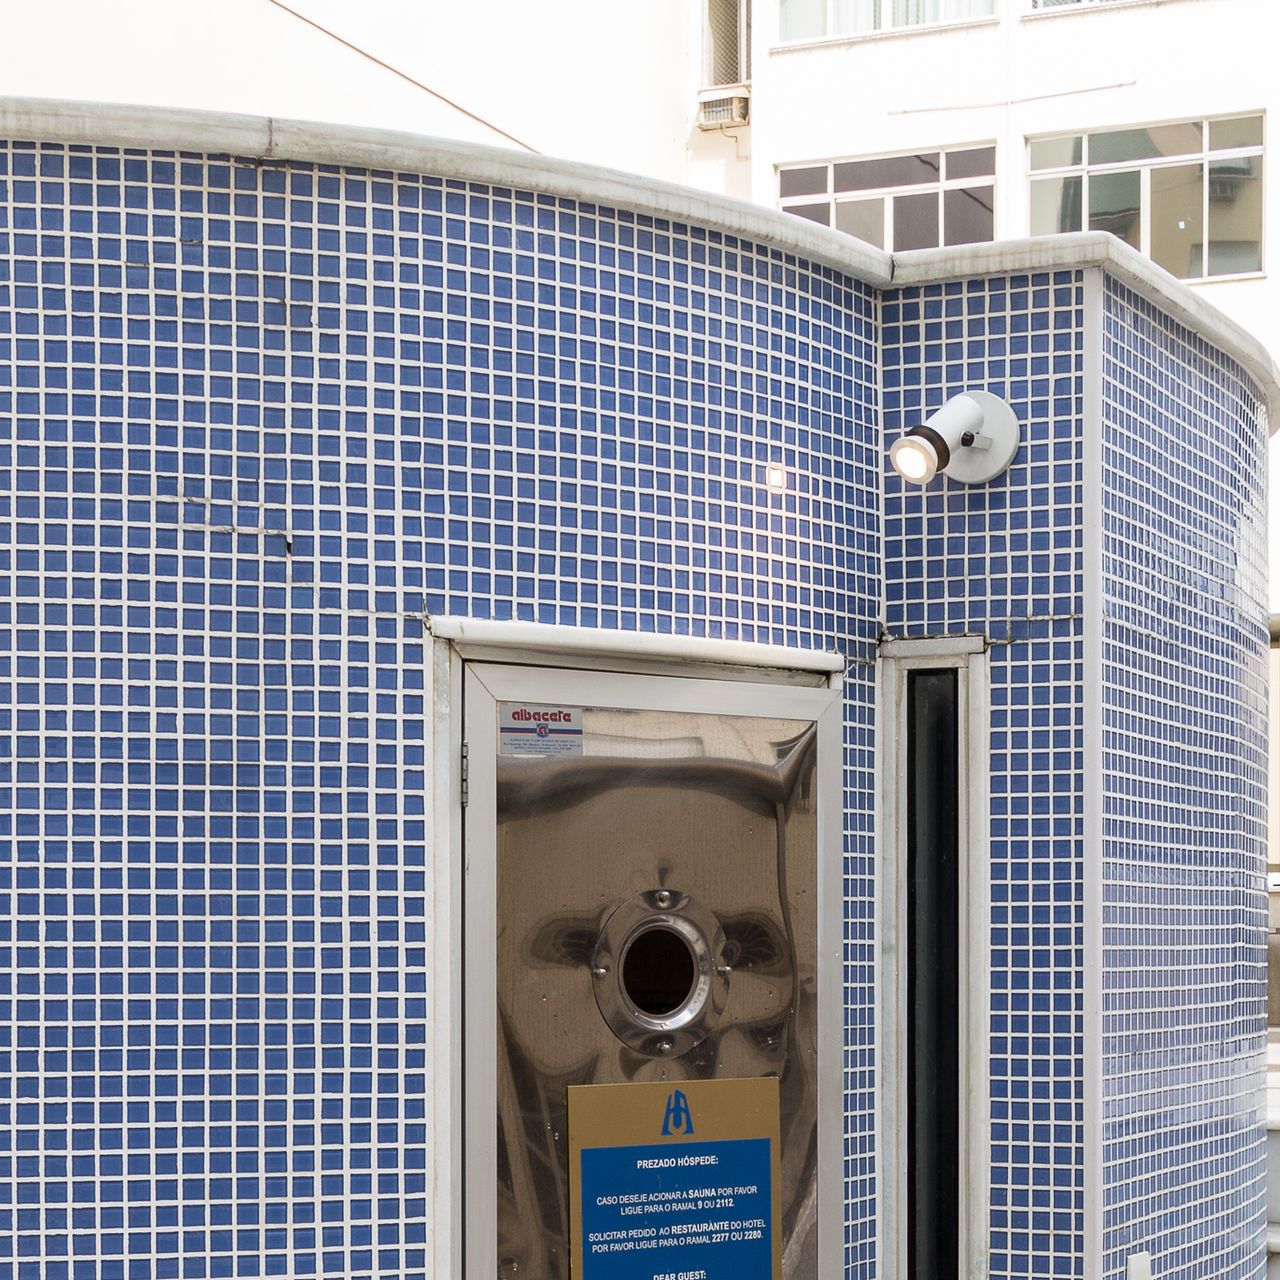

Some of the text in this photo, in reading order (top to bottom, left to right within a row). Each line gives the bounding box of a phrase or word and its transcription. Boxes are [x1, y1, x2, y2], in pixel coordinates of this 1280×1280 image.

[637, 1155, 718, 1168] PREZADO HÓSPEDE:
[597, 1197, 618, 1205] CASO
[619, 1194, 647, 1204] DESEJE
[648, 1191, 681, 1201] ACIONAR
[688, 1188, 716, 1198] SAUNA
[718, 1187, 733, 1196] POR
[734, 1186, 757, 1194] FAVOR
[621, 1206, 643, 1215] LIGUE
[644, 1205, 664, 1213] PARA
[664, 1204, 670, 1212] O
[672, 1202, 696, 1211] RAMAL
[698, 1201, 702, 1209] 9
[589, 1219, 765, 1241] SOLICITAR PEDIDO AO RESTAURANTE DO HOTEL
[592, 1244, 608, 1253] POR
[610, 1242, 634, 1251] FAVOR
[636, 1240, 657, 1249] LIGUE
[659, 1238, 678, 1247] PARA
[679, 1237, 685, 1245] O
[686, 1235, 711, 1244] RAMAL
[712, 1233, 729, 1242] 2277
[731, 1232, 743, 1240] OU
[678, 1270, 706, 1280] GUEST:
